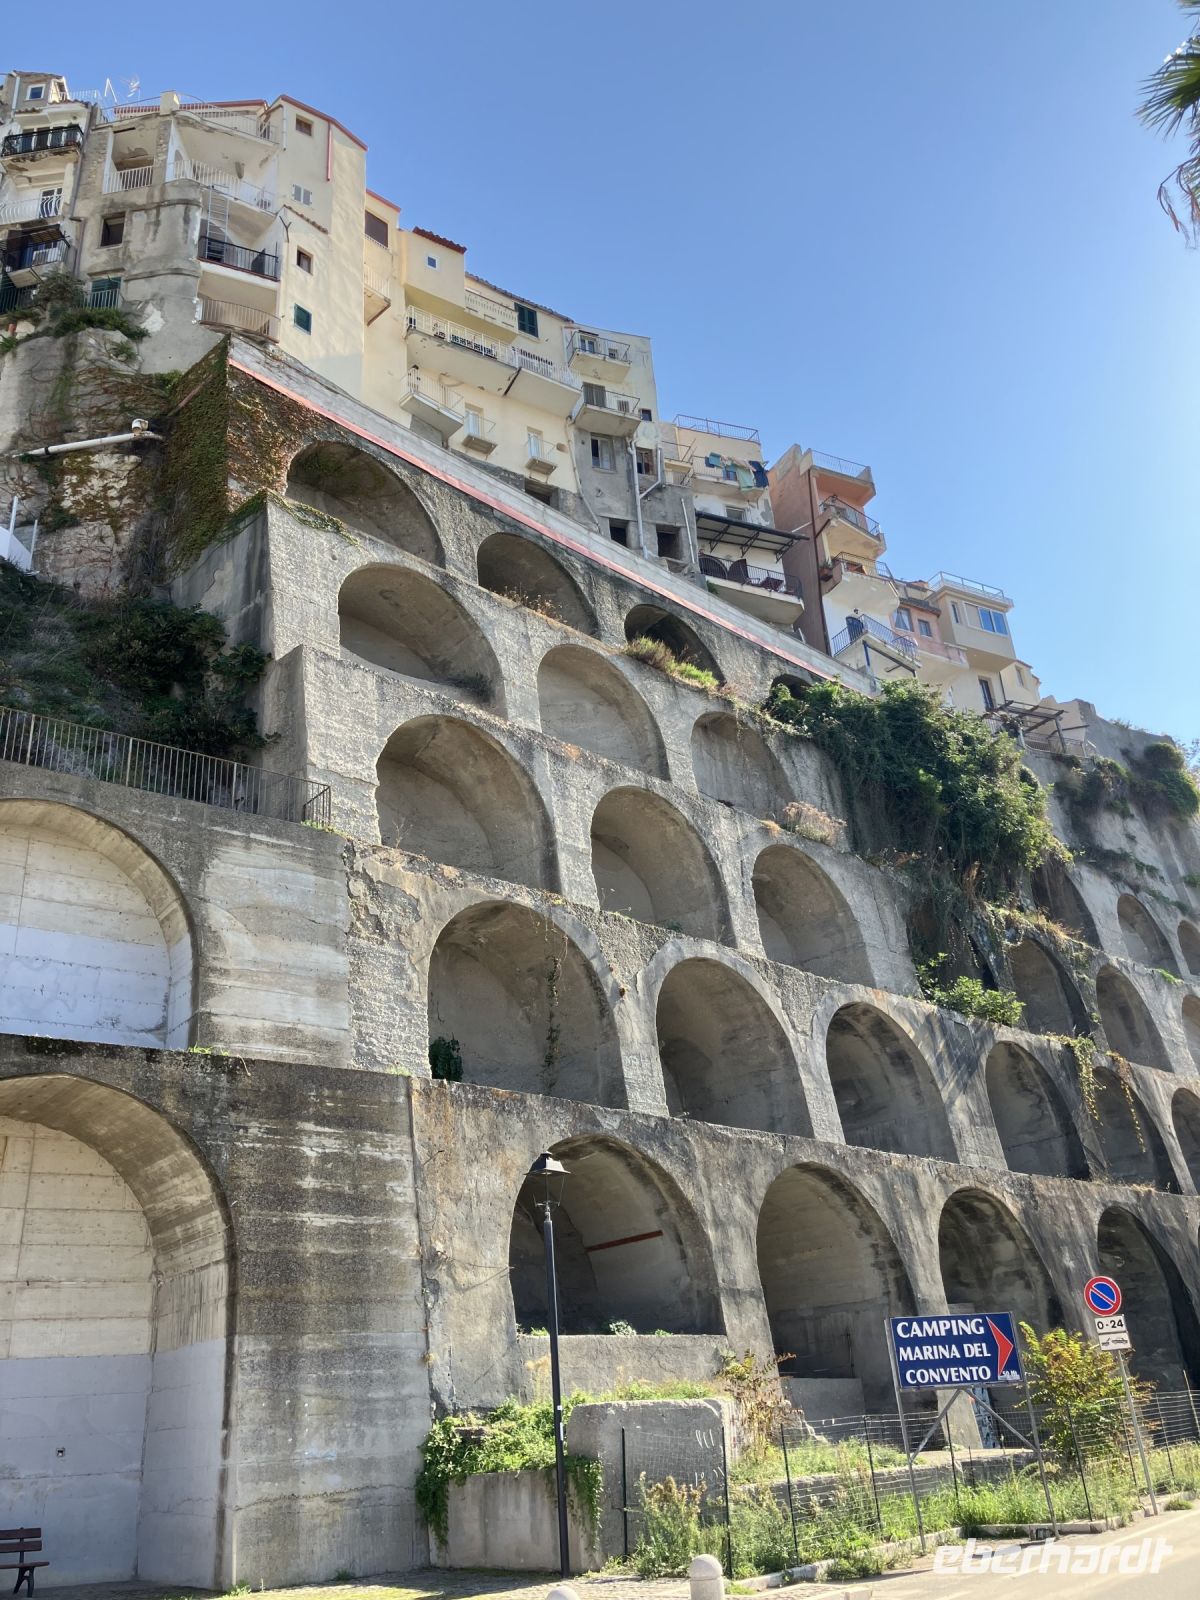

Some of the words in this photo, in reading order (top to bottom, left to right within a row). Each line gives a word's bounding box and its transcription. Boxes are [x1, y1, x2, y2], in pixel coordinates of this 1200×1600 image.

[897, 1318, 985, 1338] CAMPING
[900, 1344, 960, 1361] MARINA
[963, 1343, 991, 1358] DEL
[905, 1365, 991, 1384] CONVENTO
